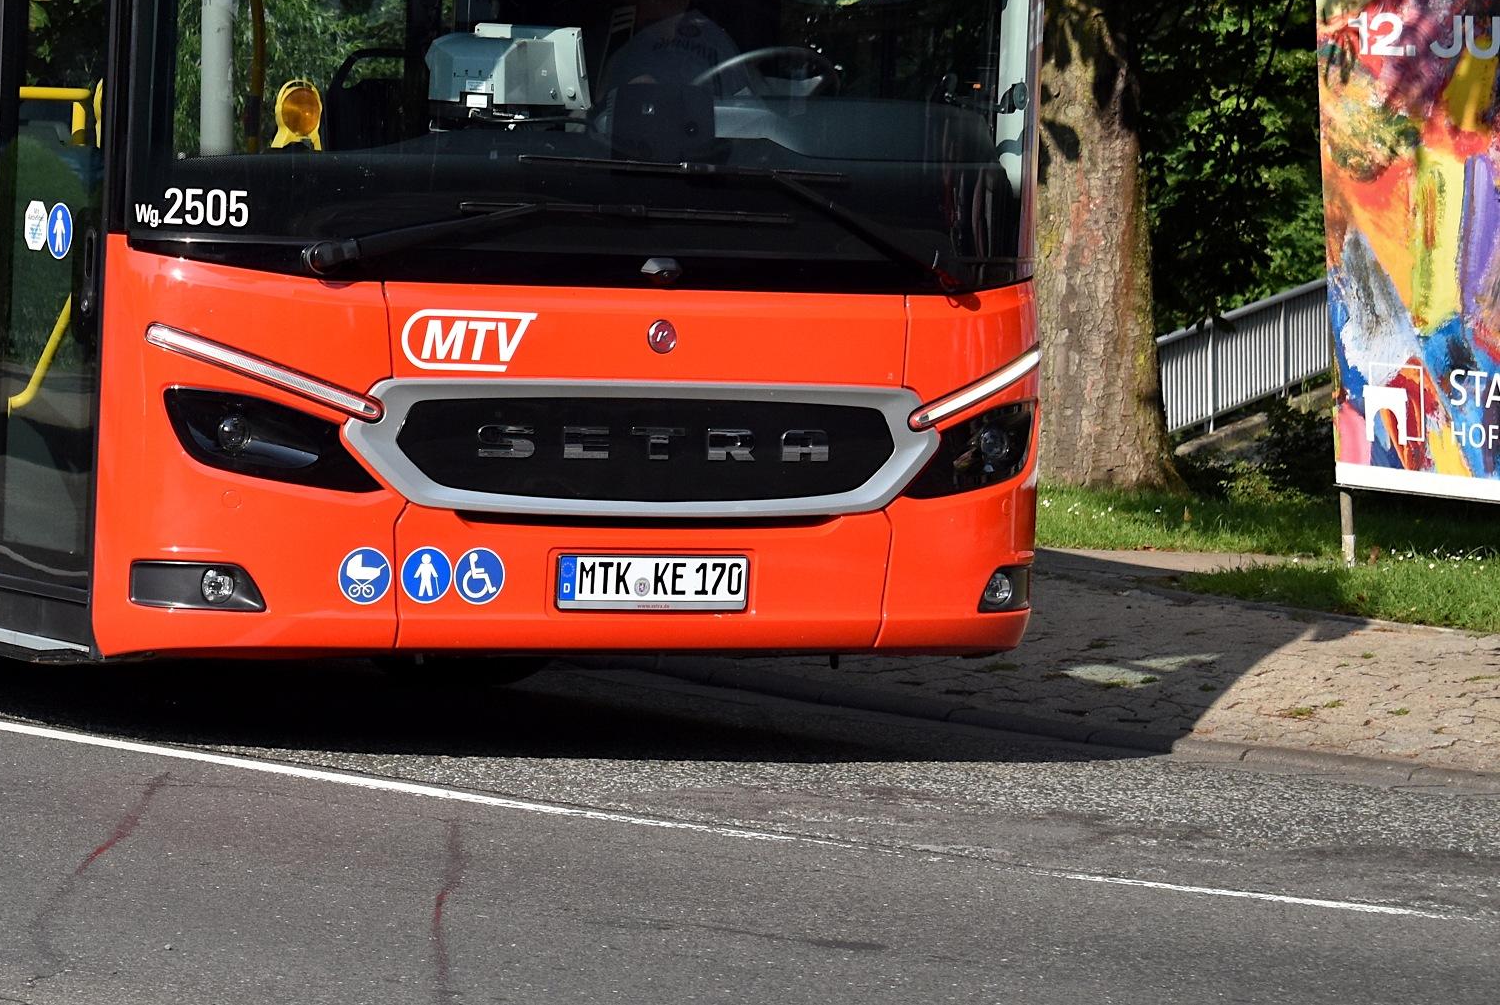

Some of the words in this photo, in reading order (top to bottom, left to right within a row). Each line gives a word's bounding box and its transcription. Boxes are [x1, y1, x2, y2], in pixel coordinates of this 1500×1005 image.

[1348, 12, 1415, 58] 12.
[1430, 14, 1500, 60] JU
[417, 311, 536, 363] MTV
[1450, 369, 1500, 409] STA
[477, 424, 830, 462] SETRA
[1451, 421, 1499, 450] HOF
[578, 561, 632, 595] MTK
[653, 562, 687, 596] KE
[694, 562, 743, 596] 170
